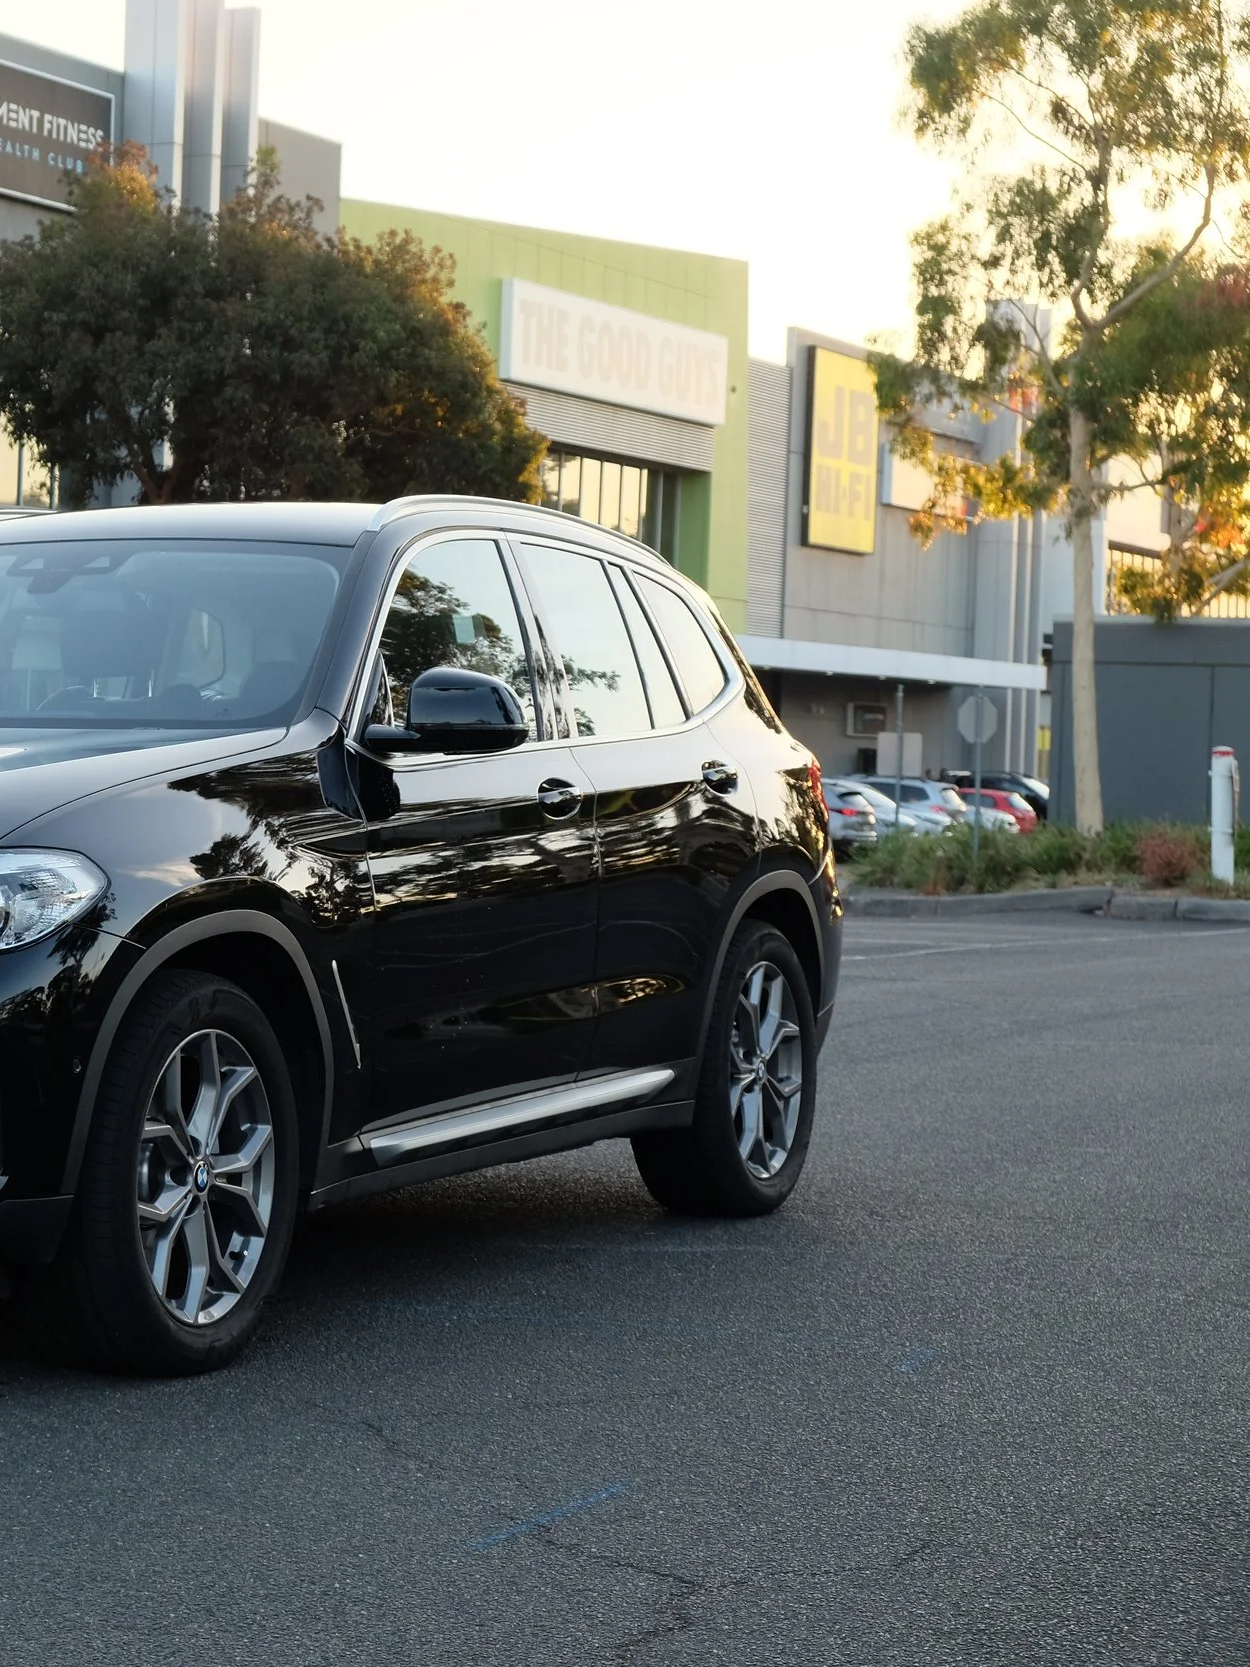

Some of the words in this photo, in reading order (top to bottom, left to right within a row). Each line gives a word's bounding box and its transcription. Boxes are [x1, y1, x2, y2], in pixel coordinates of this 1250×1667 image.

[47, 152, 85, 176] CLUB
[519, 298, 570, 374] THE
[577, 314, 651, 392] GOOD
[658, 336, 721, 408] GUYS
[817, 384, 873, 467] JB
